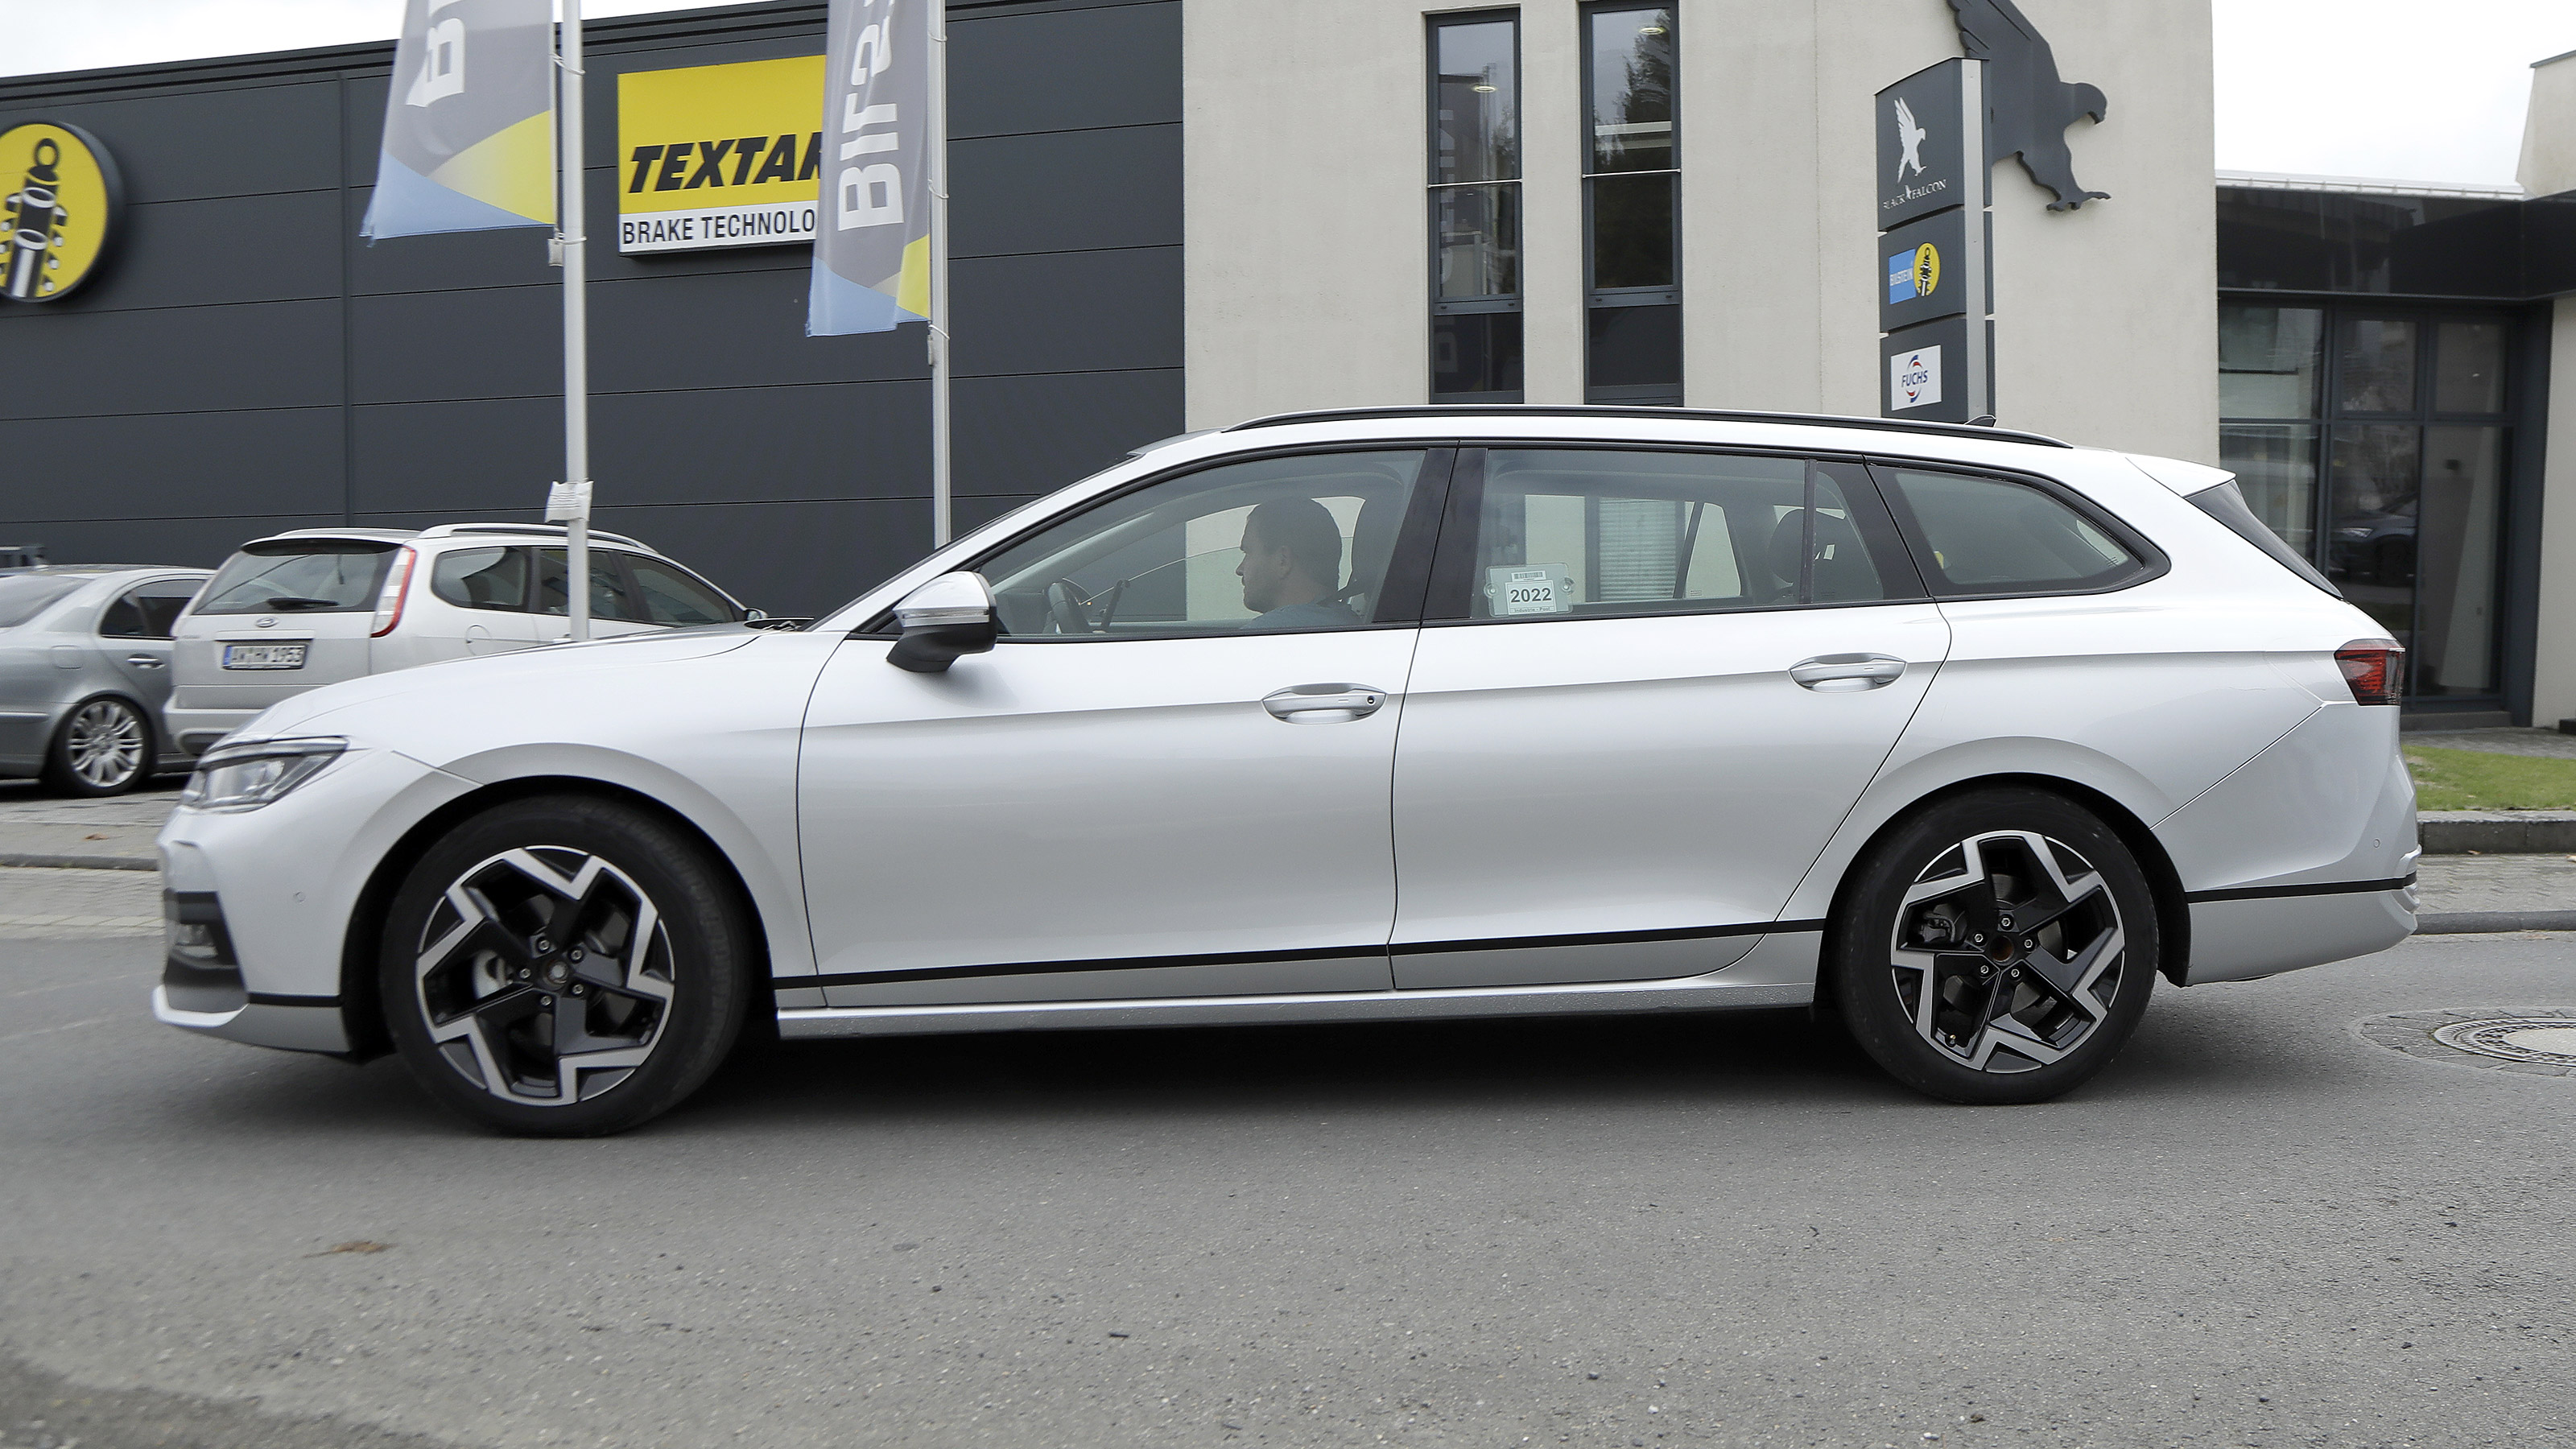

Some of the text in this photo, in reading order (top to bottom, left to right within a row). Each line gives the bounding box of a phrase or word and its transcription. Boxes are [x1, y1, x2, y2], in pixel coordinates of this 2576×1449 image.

[1911, 179, 1946, 200] FALCON
[622, 217, 693, 245] BRAKE
[1901, 369, 1928, 387] FUCHS
[1509, 587, 1552, 603] 2022
